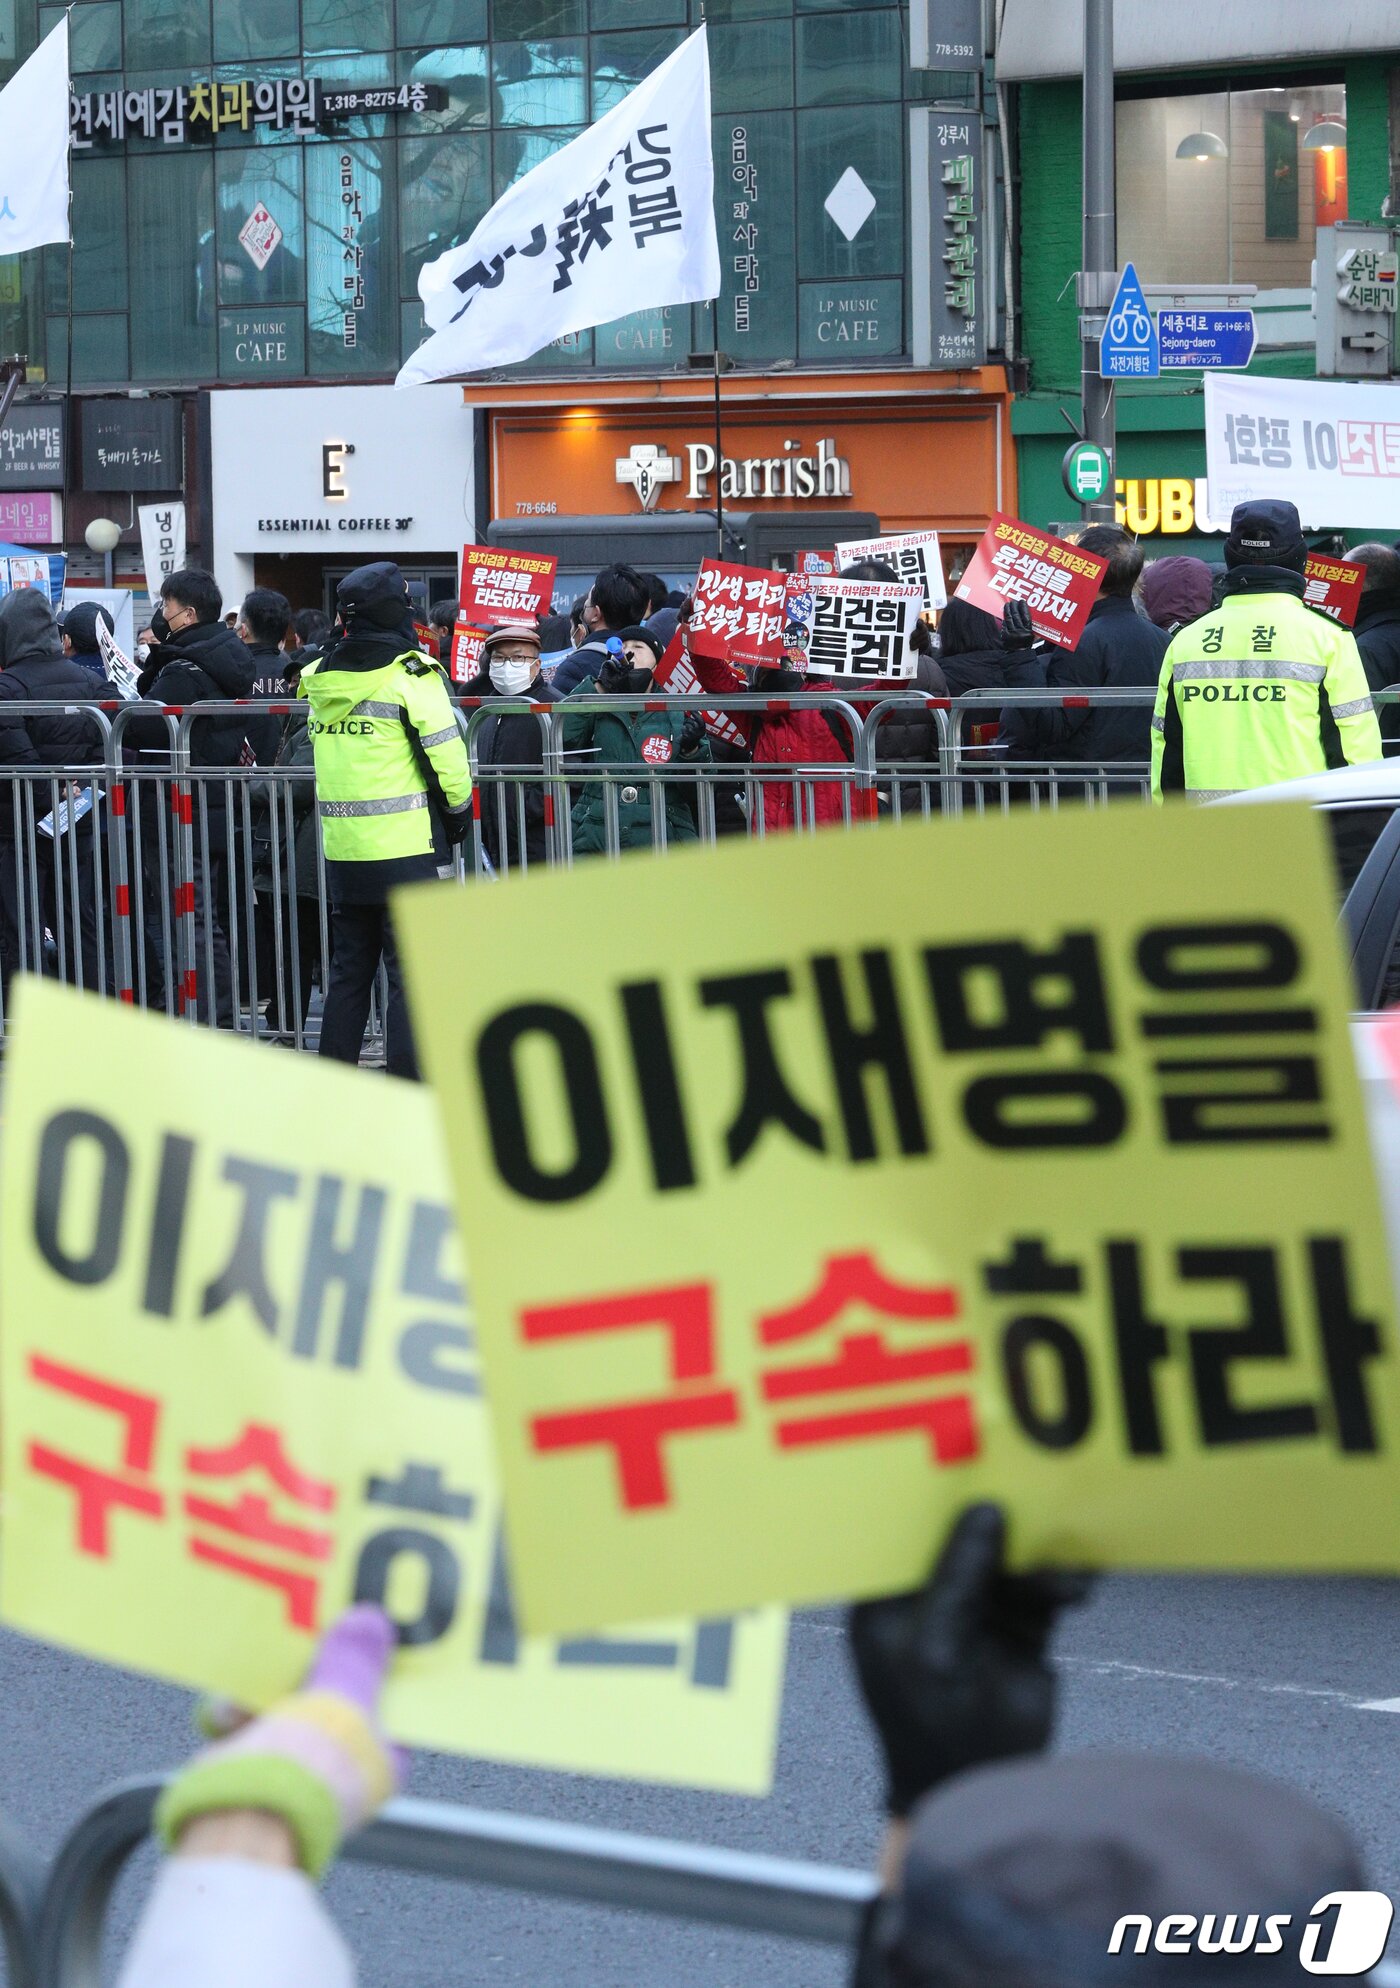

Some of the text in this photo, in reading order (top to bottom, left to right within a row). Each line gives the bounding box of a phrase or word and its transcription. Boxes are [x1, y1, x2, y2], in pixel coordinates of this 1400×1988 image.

[935, 44, 974, 56] 778-5392
[70, 79, 316, 149] 연세예감치과의원
[397, 82, 428, 113] 4층
[937, 125, 969, 146] 강루시
[943, 155, 977, 318] 피부관리
[1347, 254, 1380, 282] 순남
[819, 299, 879, 313] LP MUSIC
[1349, 285, 1394, 307] 시래기
[236, 322, 286, 335] LP MUSIC
[965, 321, 976, 333] 3F
[1161, 314, 1208, 333] 세종대로
[938, 348, 976, 359] 756-5846
[1161, 336, 1216, 350] Sejong-daero
[1110, 355, 1149, 373] 자전거횡단
[0, 428, 60, 459] 악과사람들
[13, 462, 28, 471] BEER
[322, 444, 345, 497] E
[685, 439, 850, 498] Parrish
[0, 502, 34, 528] 네일
[516, 502, 557, 515] 778-6646
[258, 519, 332, 531] ESSENTIAL
[338, 518, 391, 531] COFFEE
[840, 545, 869, 558] 주가조작
[902, 532, 936, 546] 상습사기
[994, 522, 1102, 580] 정치검찰 독재정권
[468, 551, 553, 575] 정치검찰 독재정권
[991, 544, 1073, 595] 윤석열을
[471, 567, 533, 592] 윤석열을
[841, 585, 881, 596] 허위경력
[883, 585, 924, 597] 상습사기
[474, 588, 541, 612] 타도하자!
[987, 570, 1078, 623] 타도하자!
[688, 597, 745, 641] 윤석열
[814, 595, 907, 633] 김건희
[809, 628, 905, 677] 특검!
[252, 678, 286, 695] NIK
[1183, 685, 1286, 702] POLICE
[474, 917, 1337, 1207] 이재명을
[517, 1233, 1389, 1515] 구속하라
